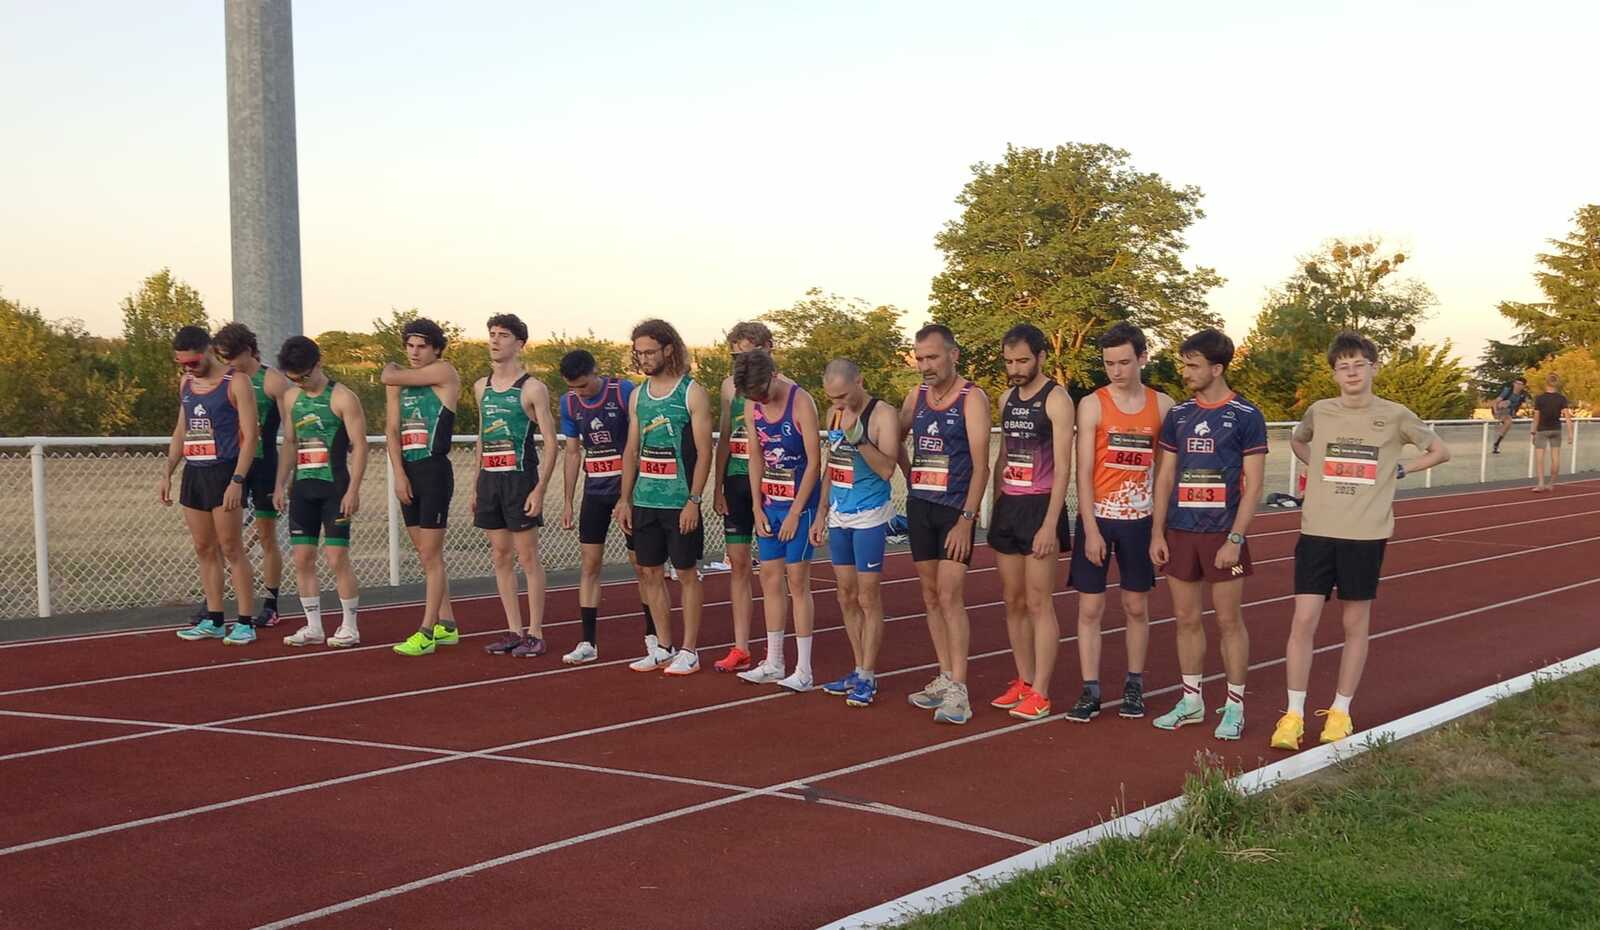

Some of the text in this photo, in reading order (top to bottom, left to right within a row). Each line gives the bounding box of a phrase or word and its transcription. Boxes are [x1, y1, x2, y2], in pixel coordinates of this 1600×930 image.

[1010, 421, 1034, 430] BARCO
[919, 436, 944, 452] E2A
[1187, 437, 1215, 453] E2A
[1116, 452, 1143, 466] 846
[592, 461, 614, 473] 837
[646, 461, 667, 474] 847
[767, 483, 787, 496] 832
[1187, 488, 1215, 502] 843
